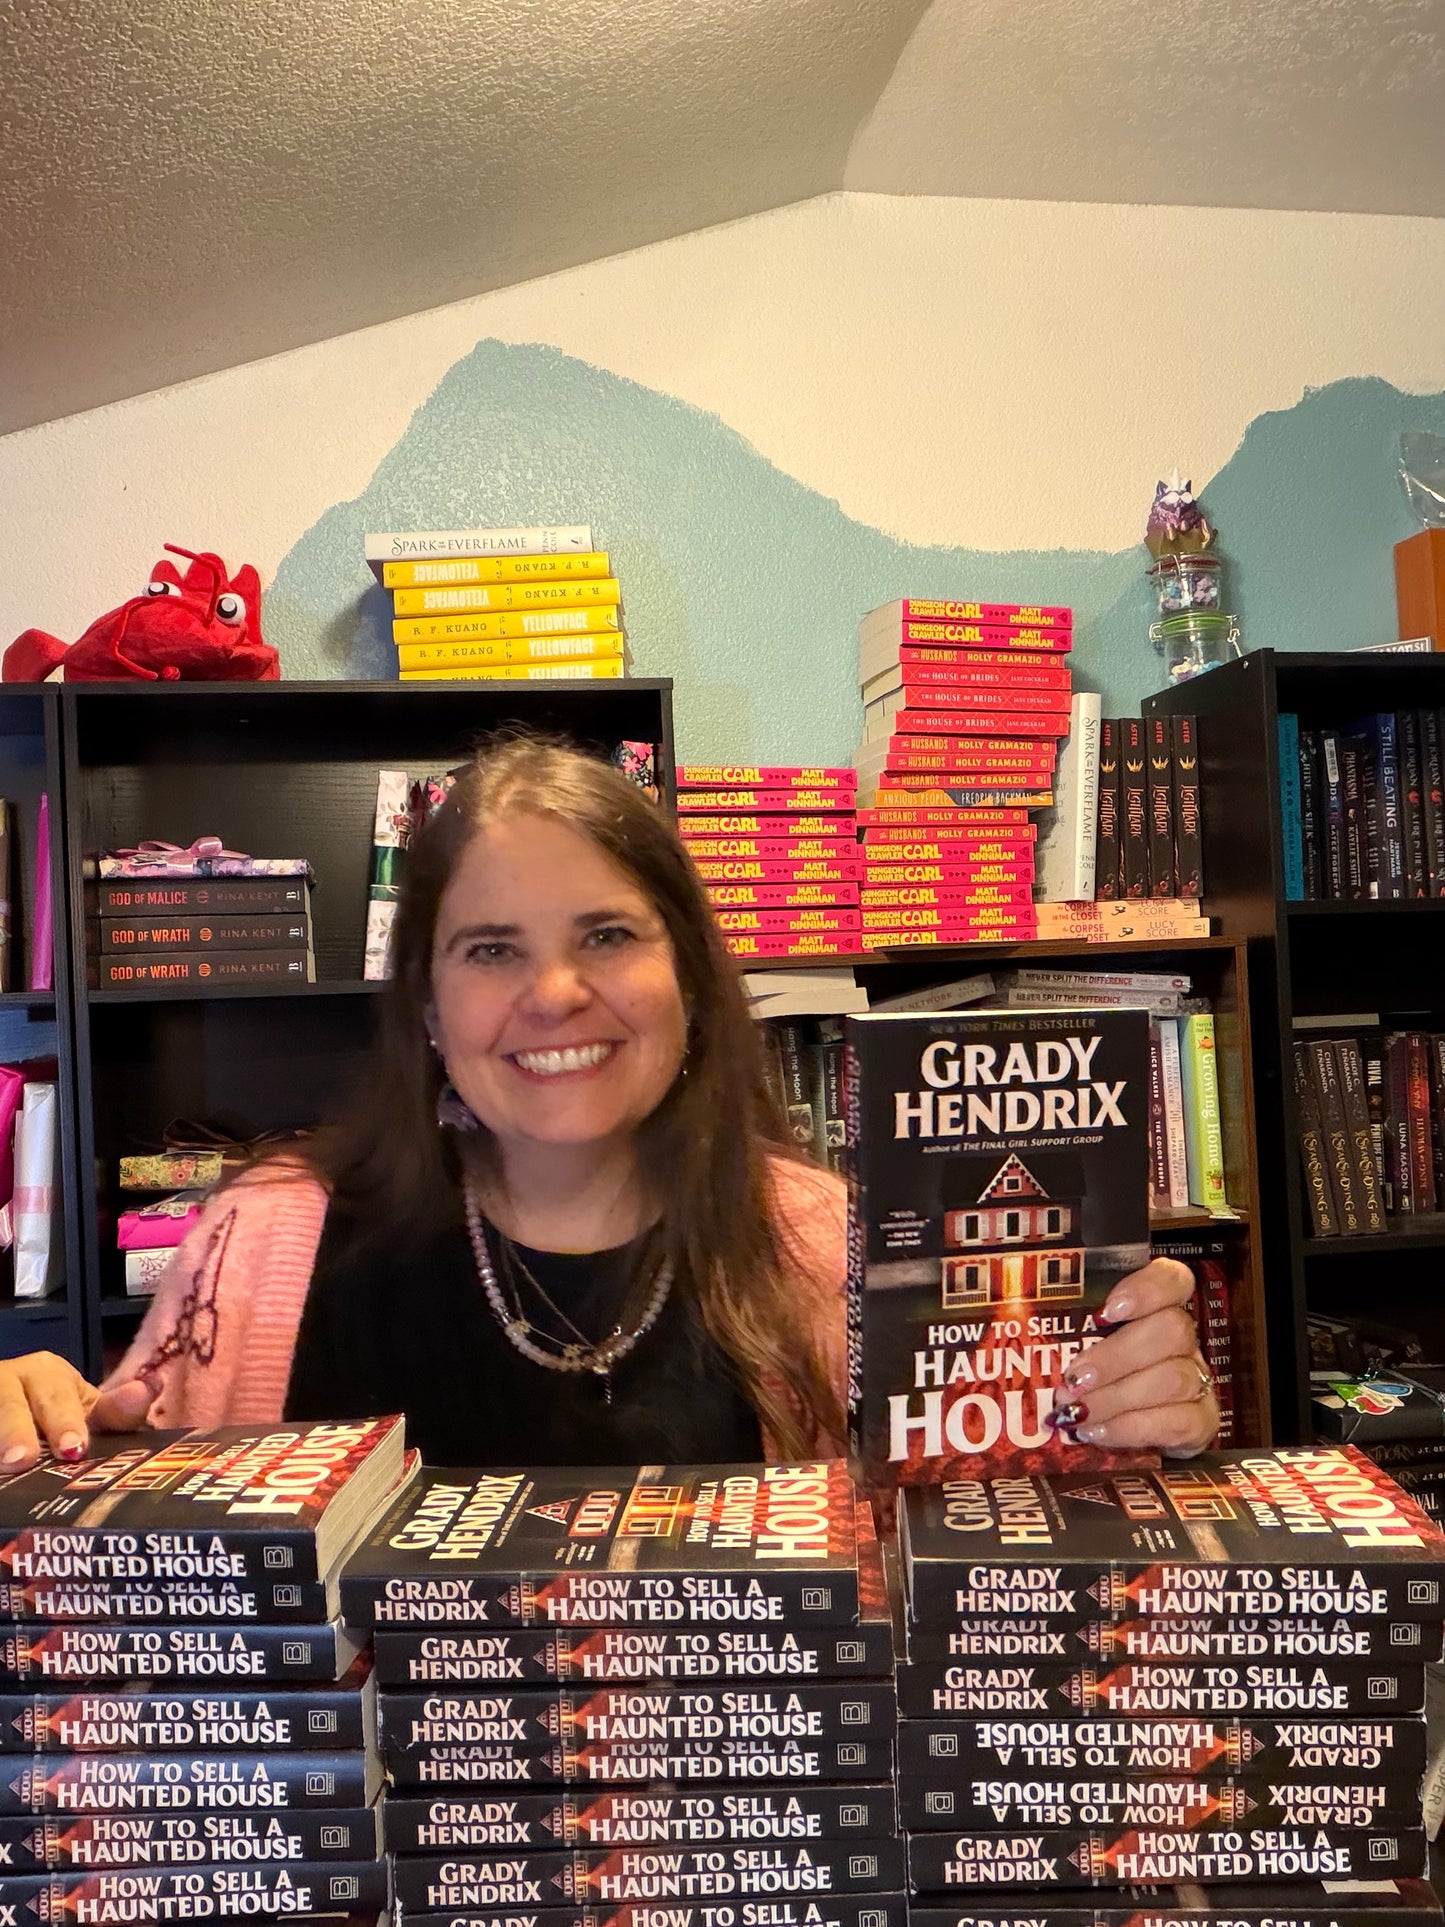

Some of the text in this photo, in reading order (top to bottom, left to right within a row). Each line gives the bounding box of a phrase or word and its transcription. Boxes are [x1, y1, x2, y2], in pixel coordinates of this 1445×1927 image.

[391, 536, 527, 556] SPARK EVERFLAME
[414, 563, 479, 583] YELLOWFACE
[514, 562, 556, 572] KUANG
[909, 600, 944, 609] DUNGEON
[909, 607, 945, 616] CRAWLER
[945, 602, 984, 619] CARL
[1019, 606, 1042, 616] MATT
[413, 623, 487, 635] R. F. KUANG
[522, 612, 588, 633] YELLOWFACE
[1009, 615, 1054, 626] DINNIMAN
[920, 651, 1042, 664] HUSBANDS HOLLY GRAMAZIO
[926, 717, 953, 726] HOUSE
[965, 718, 995, 727] BRIDES
[1130, 723, 1138, 747] ASTER
[1155, 720, 1164, 744] ASTER
[684, 767, 722, 775] DUNGEON
[684, 774, 723, 782] CRAWLER
[723, 767, 764, 783] CARL
[801, 769, 825, 778] MATT
[1381, 726, 1397, 828] STILL BEATING
[791, 777, 838, 787] DINNIMAN
[883, 791, 1033, 805] ANXIOUS PEOPLE FREDRIK BACKMAN
[1082, 767, 1095, 842] EVERFLAME
[879, 811, 1004, 822] HUSBANDS HOLLY GRAMAZIO
[109, 891, 188, 906] GOD OF MALICE
[861, 889, 898, 899] DUNGEON
[898, 887, 939, 905] CARL
[965, 894, 1012, 905] DINNIMAN
[975, 887, 999, 896] MATT
[861, 897, 899, 906] CRAWLER
[1064, 902, 1098, 911] CORPSE
[1070, 911, 1103, 921] CLOSET
[1138, 906, 1169, 916] SCORE
[1069, 924, 1104, 933] CORPSE
[1146, 928, 1179, 938] SCORE
[1149, 920, 1175, 930] LUCY
[112, 928, 282, 944] GOD OF WRATH RINA KENT
[1053, 974, 1072, 983] SPLIT
[1074, 974, 1087, 983] THE
[1089, 976, 1133, 986] DIFFERENCE
[1029, 1018, 1097, 1031] BESTSELLER
[920, 1036, 1103, 1089] GRADY
[1368, 1060, 1382, 1086] RIVAL
[793, 1073, 802, 1101] Moon
[894, 1081, 1128, 1140] HENDRIX
[1202, 1053, 1220, 1167] Growing Home
[962, 1135, 1104, 1151] THE FINAL GIRL SUPPORT GROUP
[1399, 1122, 1409, 1189] LUNA MASON
[1209, 1281, 1222, 1290] DID
[1209, 1299, 1224, 1309] YOU
[928, 1314, 1098, 1346] HOW TO SELL A
[1208, 1318, 1228, 1328] HEAR
[1207, 1336, 1231, 1347] ABOUT
[1210, 1355, 1231, 1366] KITTY
[887, 1388, 1078, 1462] HOU
[389, 1484, 473, 1550] GRADY
[430, 1473, 526, 1560] HENDRIX
[711, 1476, 759, 1549] HAUNTED
[756, 1464, 828, 1559] HOUSE
[686, 1519, 710, 1543] HOW
[969, 1568, 1062, 1590] GRADY
[1161, 1567, 1367, 1590] HOW TO SELL A
[385, 1580, 475, 1601] GRADY
[568, 1577, 764, 1598] HOW TO SELL A
[547, 1597, 784, 1621] HAUNTED HOUSE
[956, 1589, 1076, 1613] HENDRIX
[1138, 1588, 1388, 1614] HAUNTED HOUSE
[374, 1600, 489, 1622] HENDRIX
[81, 1699, 271, 1722] HOW TO SELL A
[59, 1720, 292, 1745] HAUNTED HOUSE
[976, 1723, 1214, 1749] HAUNTED HOUSE
[1275, 1723, 1393, 1748] HENDRIX
[996, 1747, 1191, 1768] HOW TO SELL A
[1287, 1747, 1381, 1769] GRADY
